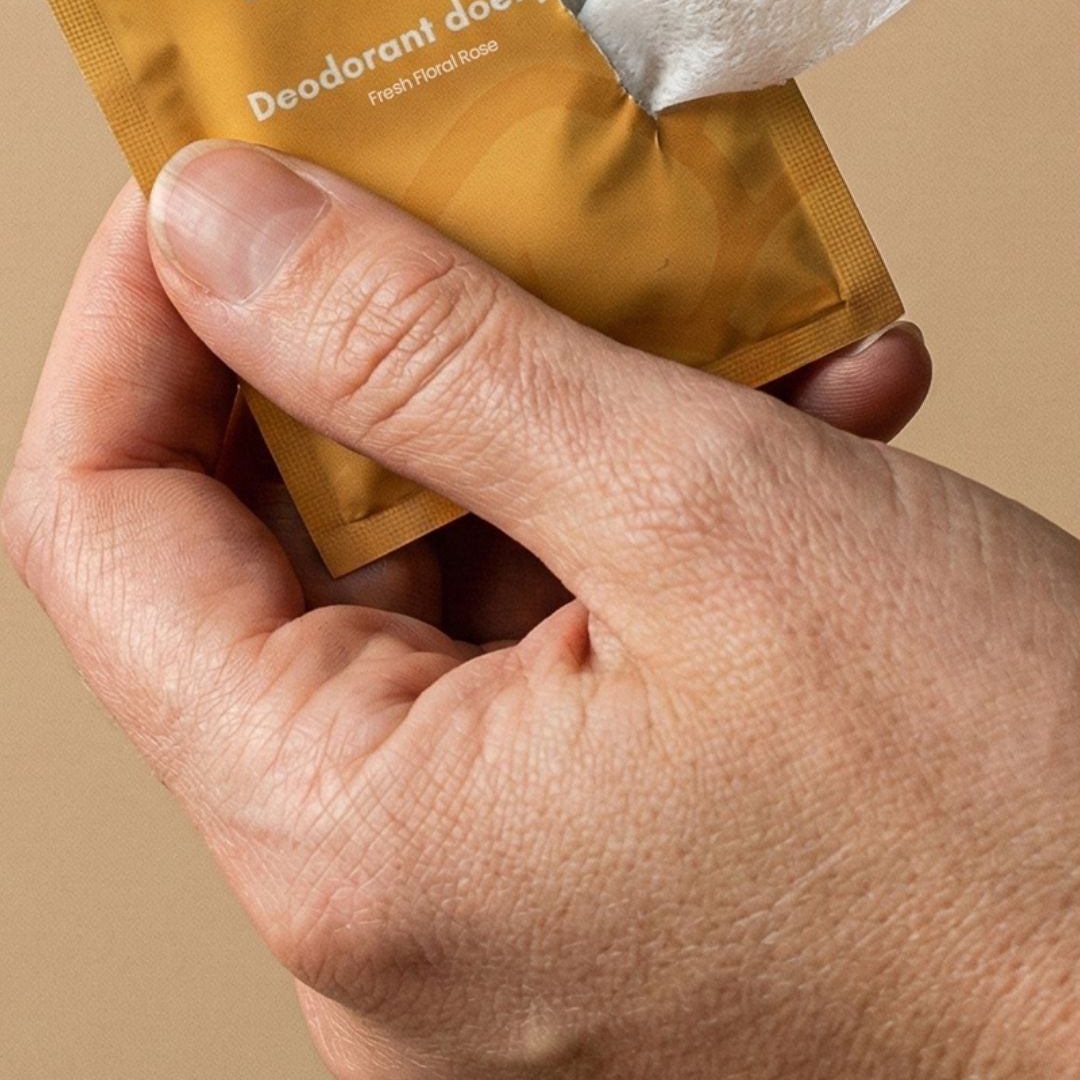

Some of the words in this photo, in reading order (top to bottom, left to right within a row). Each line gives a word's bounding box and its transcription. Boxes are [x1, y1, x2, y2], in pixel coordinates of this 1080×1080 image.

[248, 17, 437, 122] Deodorant
[368, 78, 413, 106] Fresh
[413, 55, 458, 85] Floral
[458, 39, 499, 65] Rose
